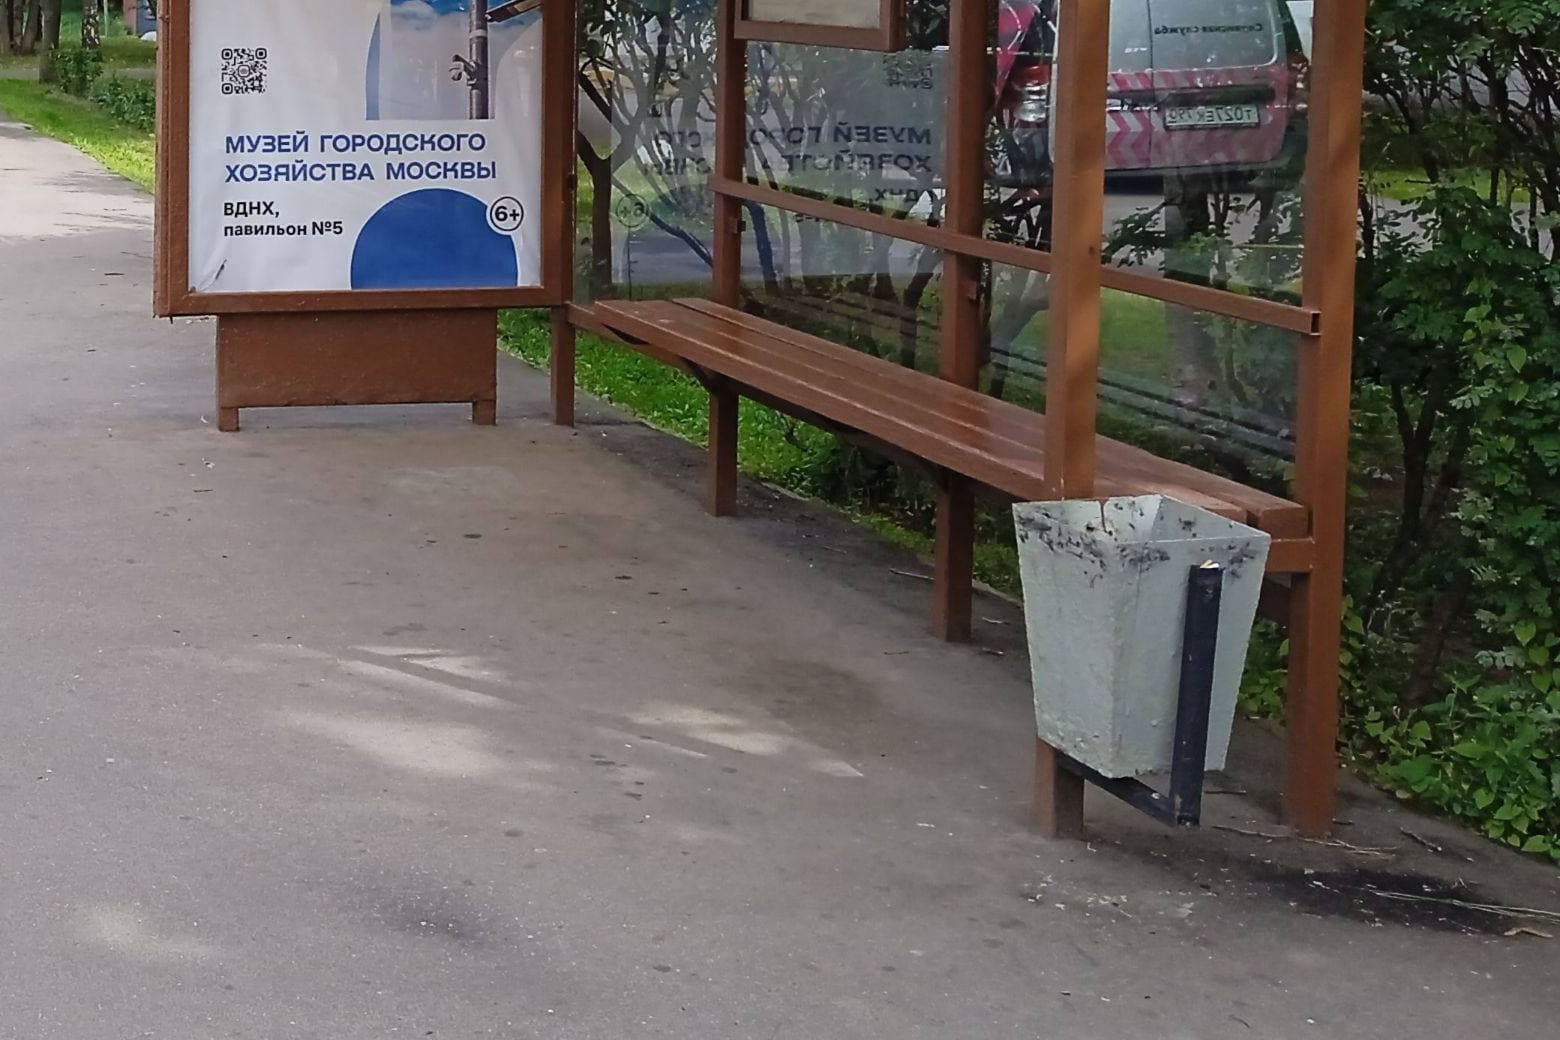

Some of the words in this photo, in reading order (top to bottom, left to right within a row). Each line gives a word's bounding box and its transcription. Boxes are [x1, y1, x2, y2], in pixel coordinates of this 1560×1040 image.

[225, 130, 309, 154] МУЗЕЙ
[320, 133, 486, 155] ГОРОДСКОГО
[225, 159, 374, 183] ХОЗЯЙСТВА
[386, 161, 497, 180] МОСКВЫ
[223, 201, 280, 218] ВДНХ,
[494, 205, 521, 223] 6+
[223, 222, 307, 237] павильон
[311, 220, 343, 236] №5
